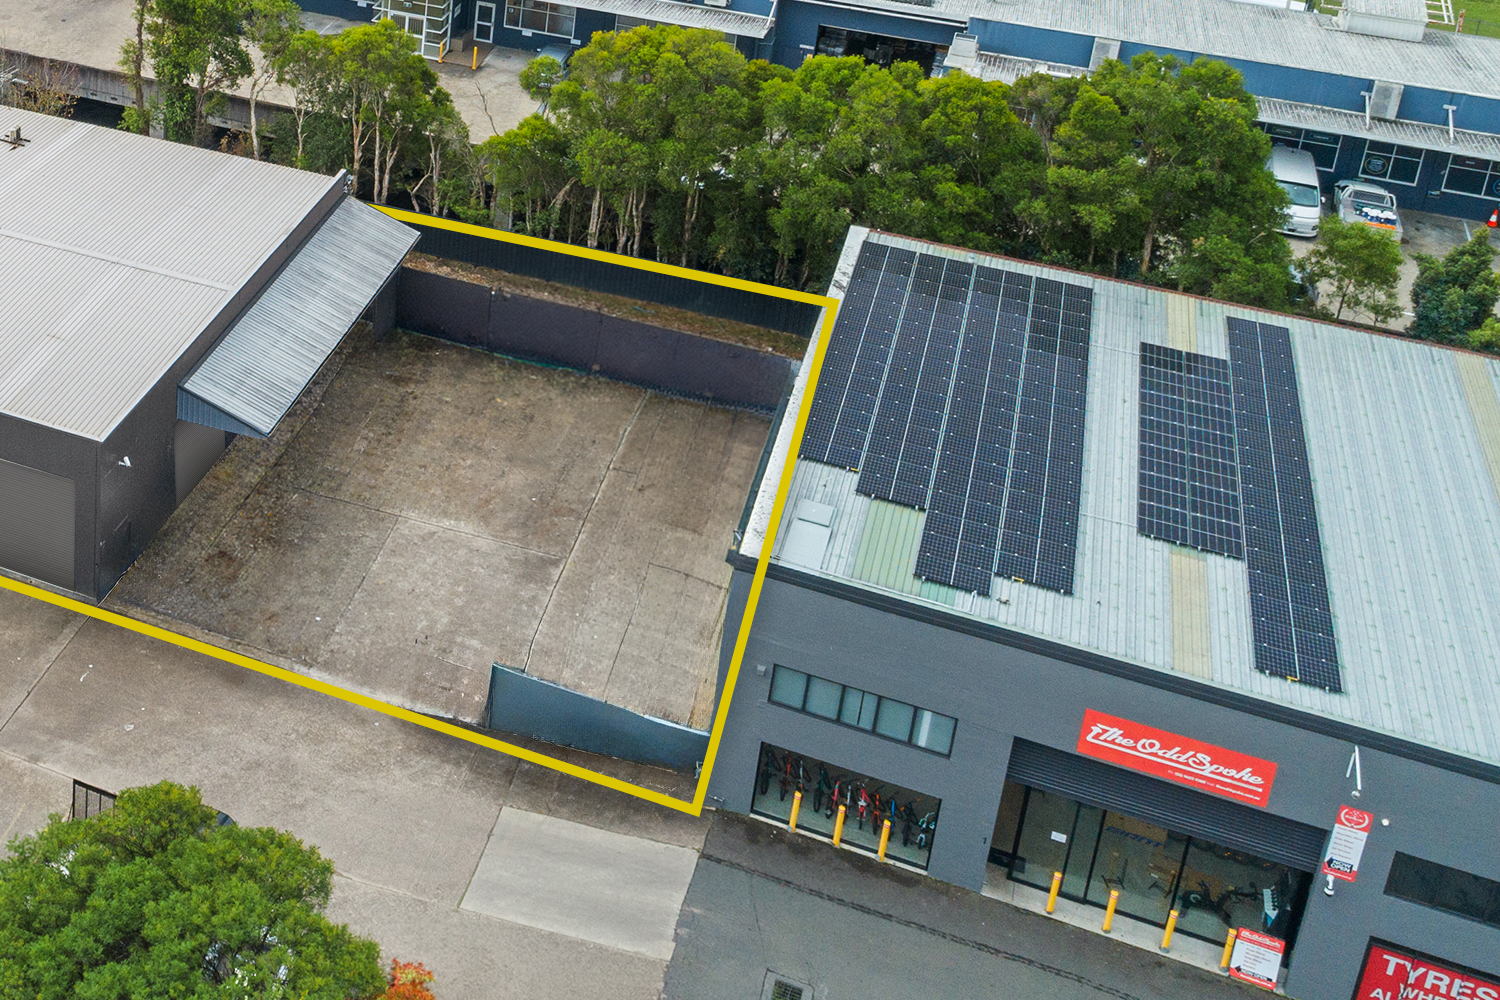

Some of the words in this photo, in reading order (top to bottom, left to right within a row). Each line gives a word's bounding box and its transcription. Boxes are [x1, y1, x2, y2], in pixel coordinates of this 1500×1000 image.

[1093, 723, 1136, 747] The
[1136, 738, 1195, 763] Odd
[1187, 753, 1264, 784] Spoke
[1382, 954, 1499, 1000] TYRES
